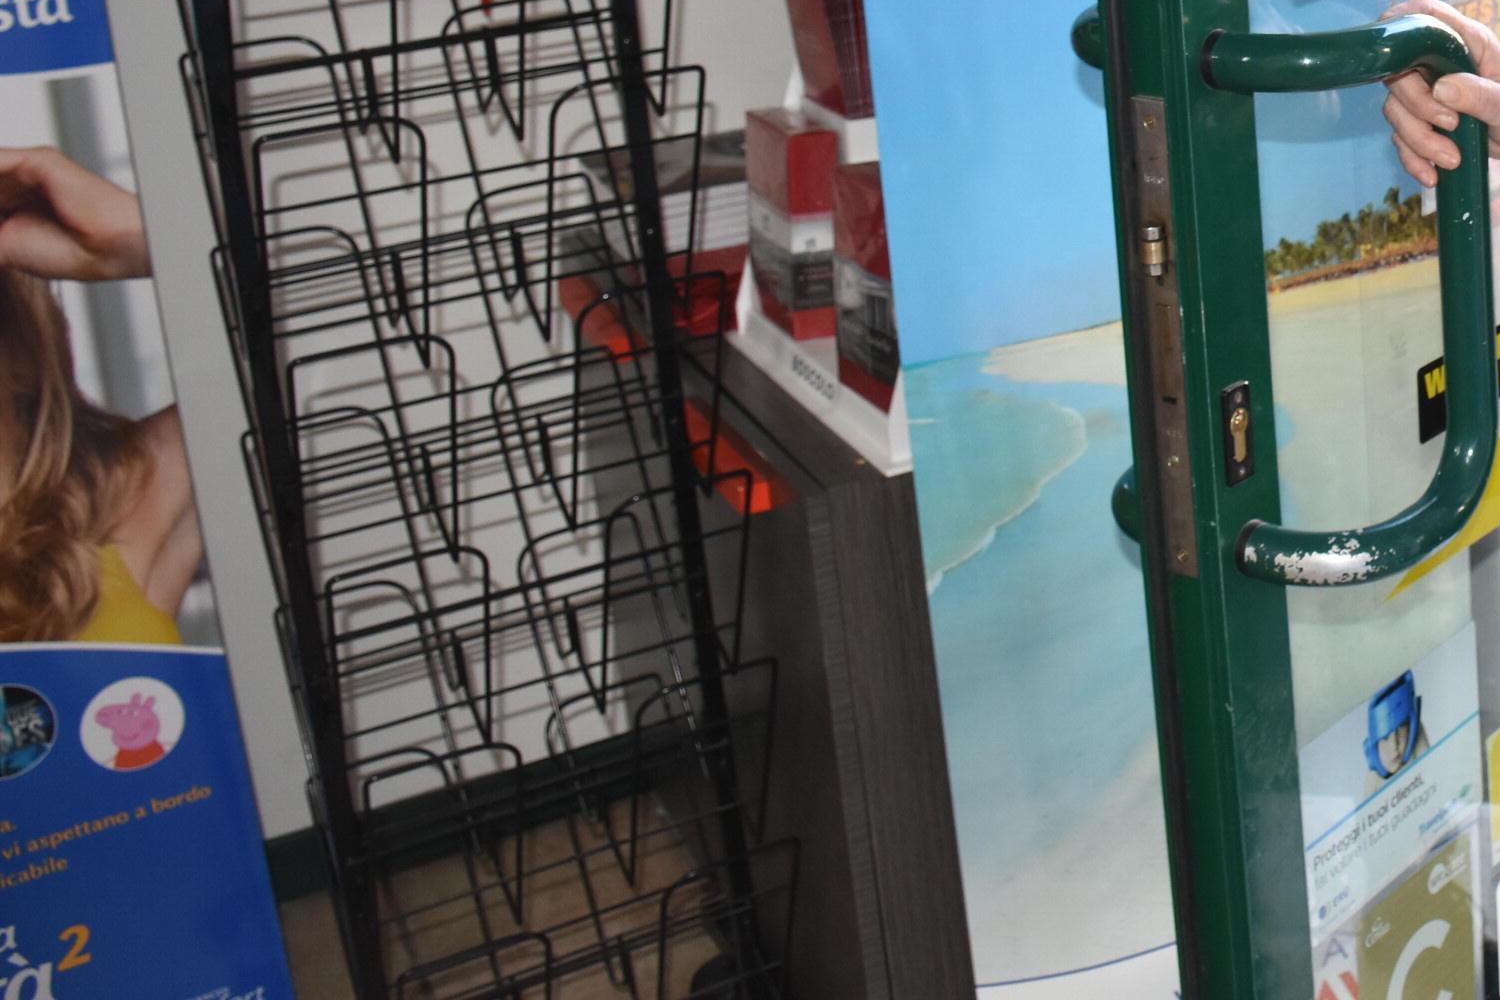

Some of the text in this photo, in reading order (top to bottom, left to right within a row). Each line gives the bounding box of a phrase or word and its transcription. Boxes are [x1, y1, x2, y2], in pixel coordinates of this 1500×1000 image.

[2, 785, 212, 860] vi aspettano a bordo
[1313, 822, 1360, 872] Proteggi
